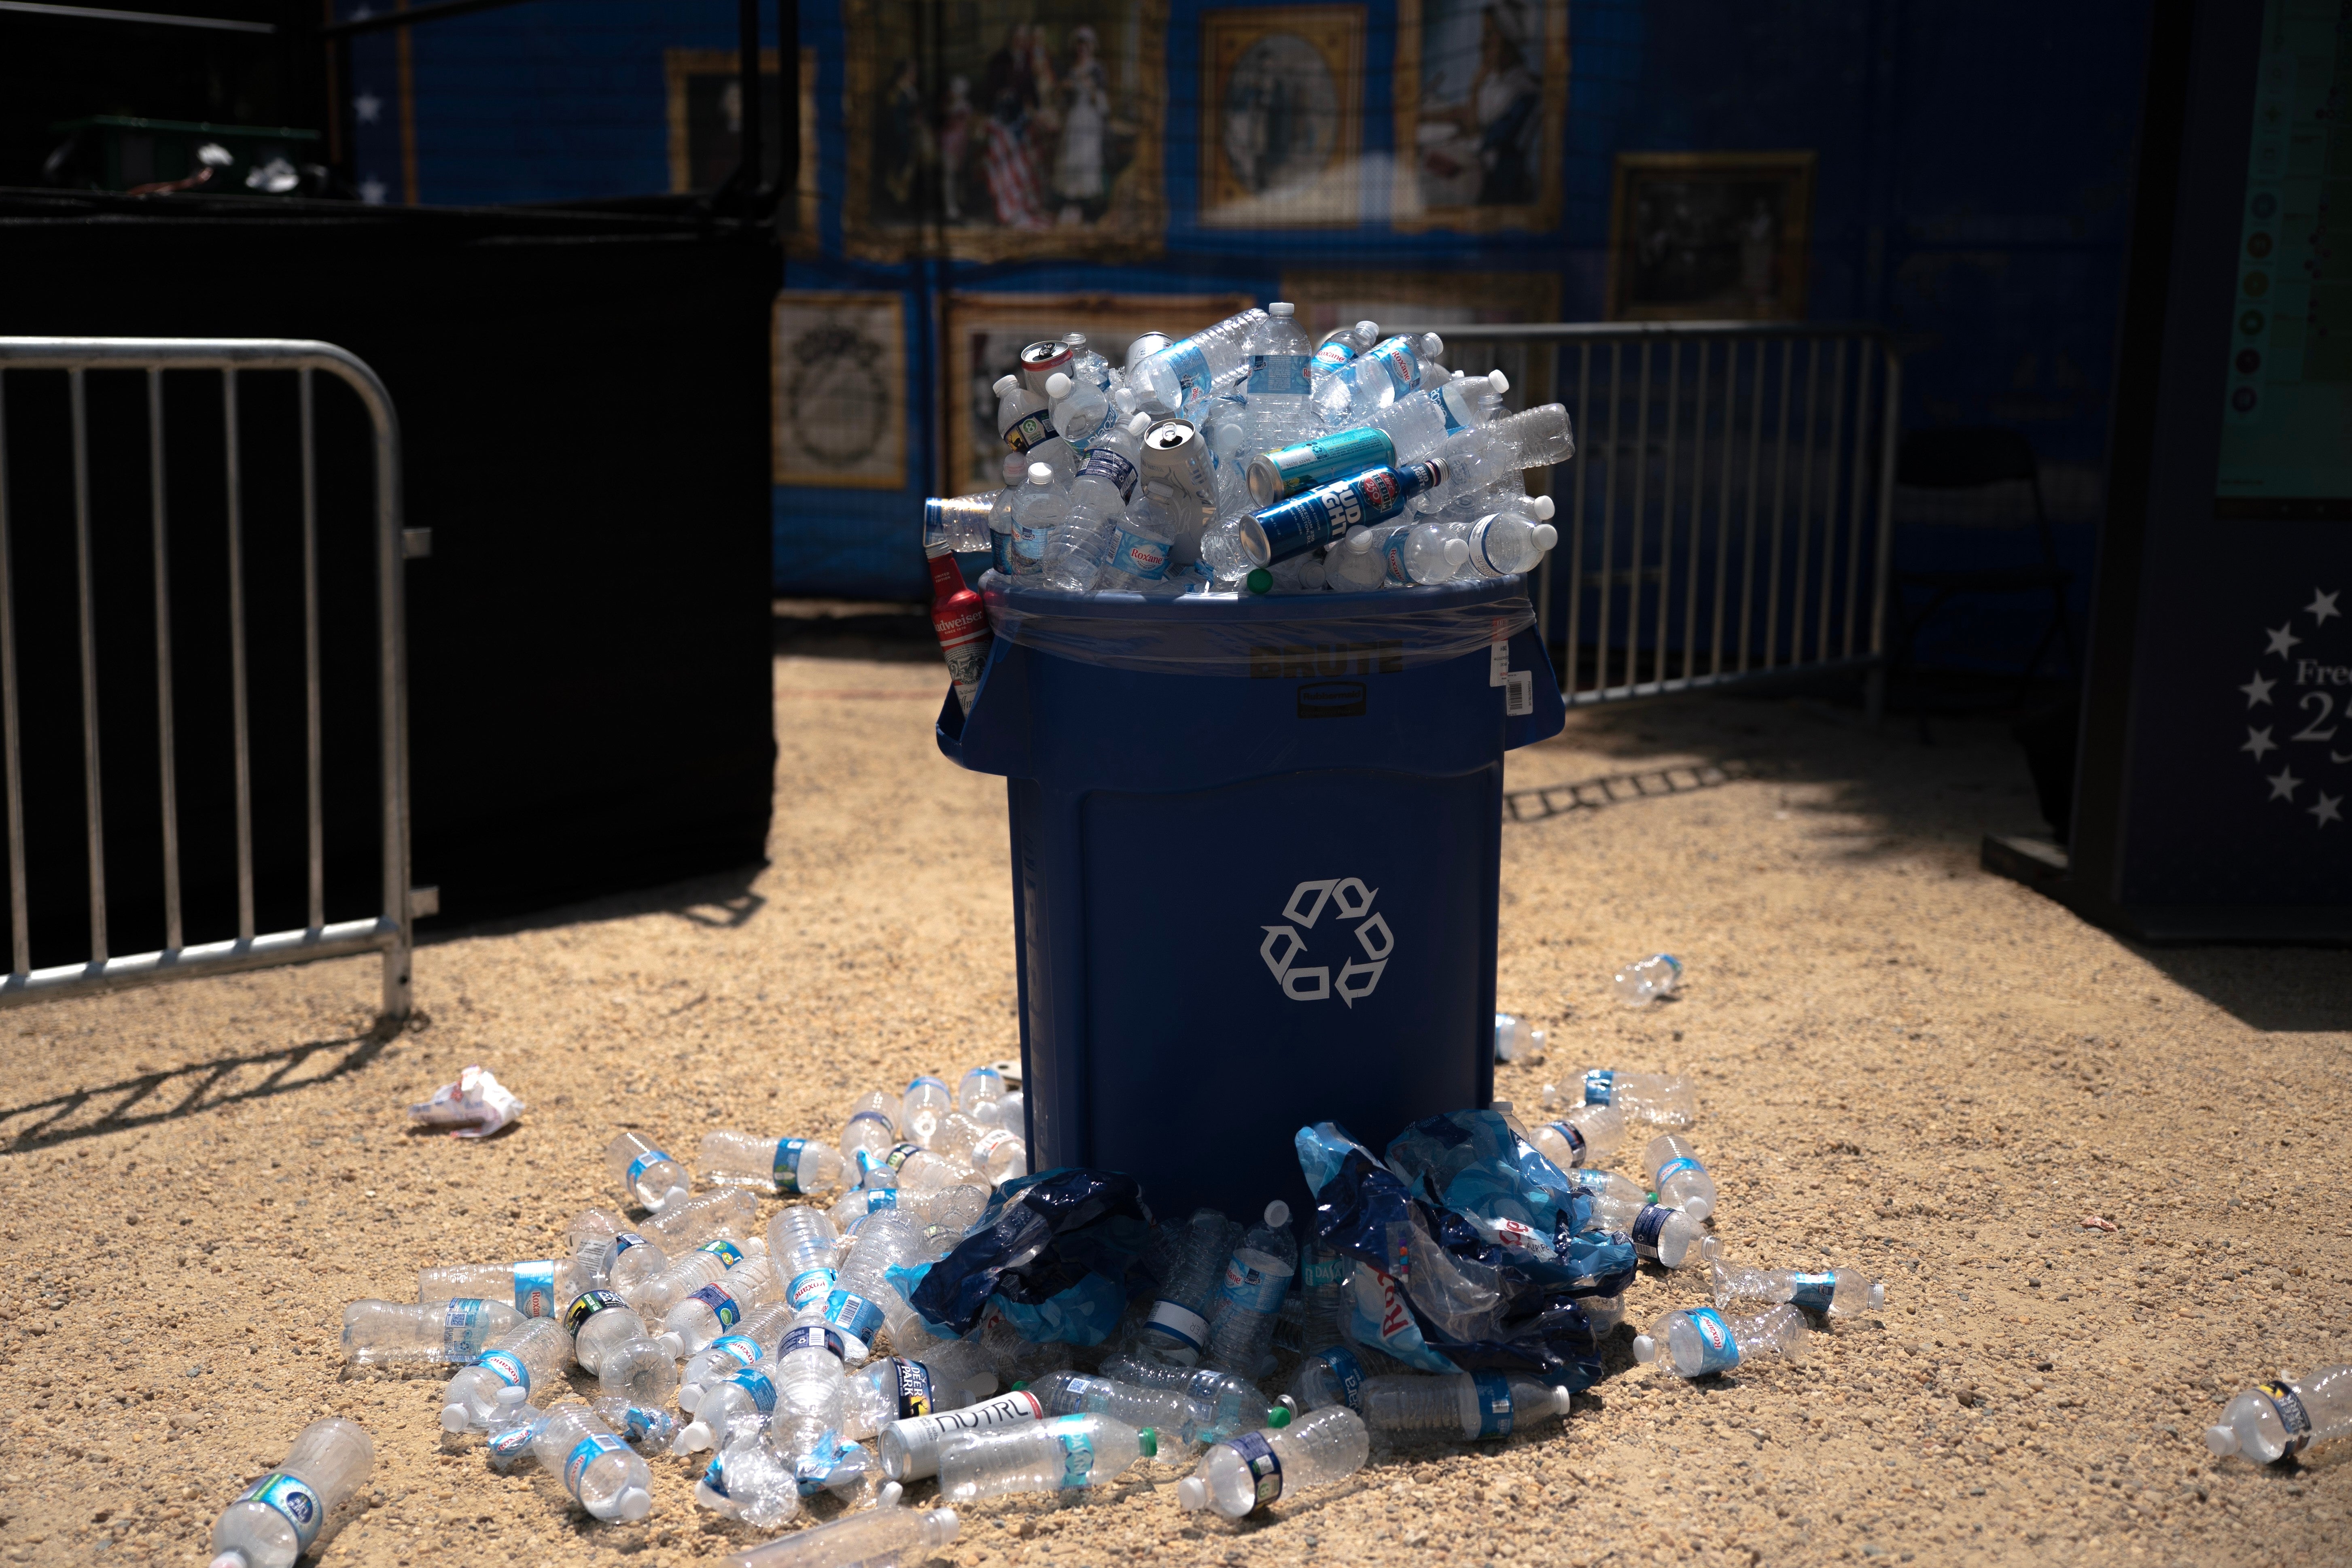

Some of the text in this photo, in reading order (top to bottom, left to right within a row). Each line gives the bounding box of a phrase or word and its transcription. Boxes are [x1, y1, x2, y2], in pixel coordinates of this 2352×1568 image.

[1316, 350, 1345, 363] Roxane
[1391, 351, 1410, 382] Roxane
[1384, 477, 1394, 490] UFC
[1410, 466, 1425, 488] LIGHT
[1417, 466, 1429, 482] BUD
[1328, 480, 1361, 524] BUD
[1366, 482, 1380, 500] 250
[1313, 512, 1321, 530] EDITION
[1131, 548, 1164, 565] Roxane
[934, 611, 983, 632] udweiser
[1250, 639, 1403, 679] BRUTE
[2295, 658, 2352, 686] Fre
[1303, 690, 1361, 701] Rubbermaid
[532, 1292, 541, 1318] Roxan
[583, 1294, 594, 1306] RECYCLED
[1703, 1318, 1722, 1349] Roxane
[490, 1357, 520, 1384] Roxane
[901, 1365, 913, 1396] PARK
[910, 1367, 923, 1396] DEER
[2278, 1398, 2299, 1431] DEER
[2284, 1395, 2305, 1429] PARK
[288, 1501, 305, 1521] Pure
[294, 1498, 309, 1515] Life
